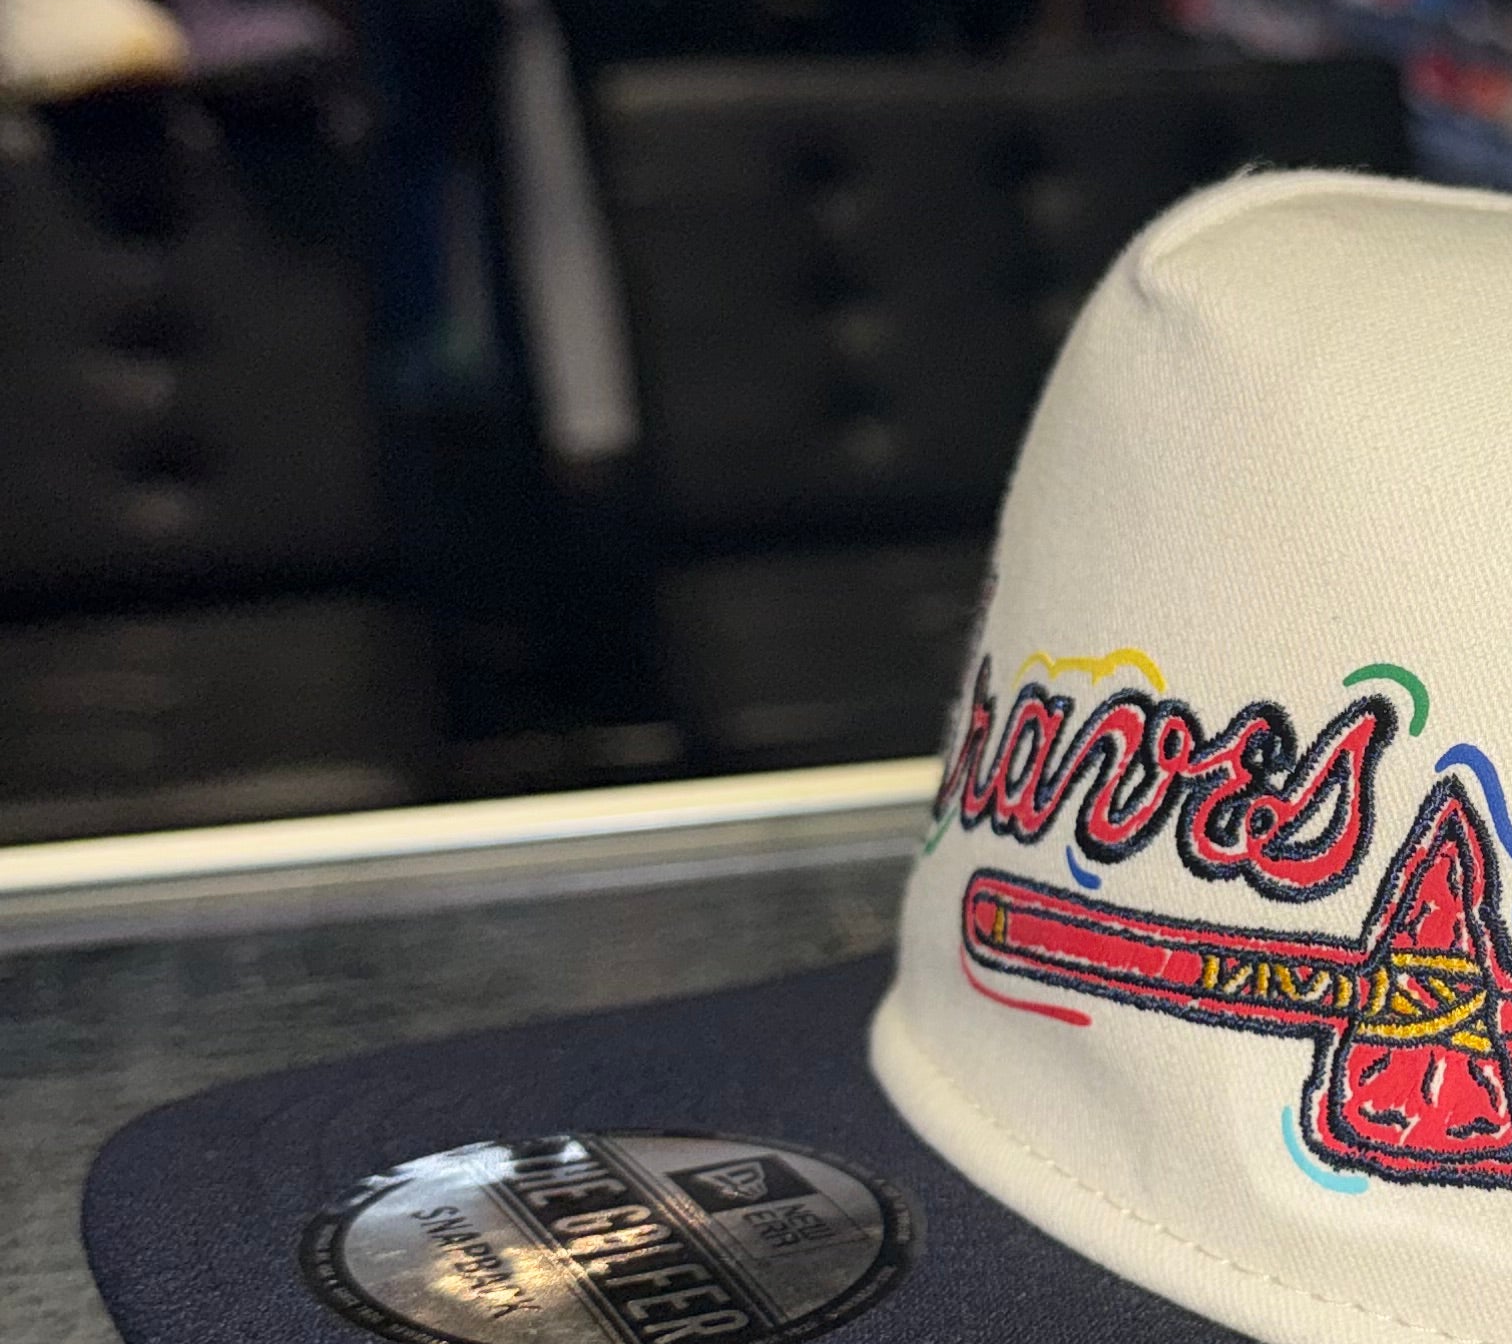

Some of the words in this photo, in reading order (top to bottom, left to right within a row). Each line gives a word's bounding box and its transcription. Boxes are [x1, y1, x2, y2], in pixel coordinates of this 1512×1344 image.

[932, 654, 1398, 902] raves
[510, 1143, 627, 1206] THE
[411, 1207, 542, 1318] SNAPBACK
[783, 1204, 836, 1241] NEW
